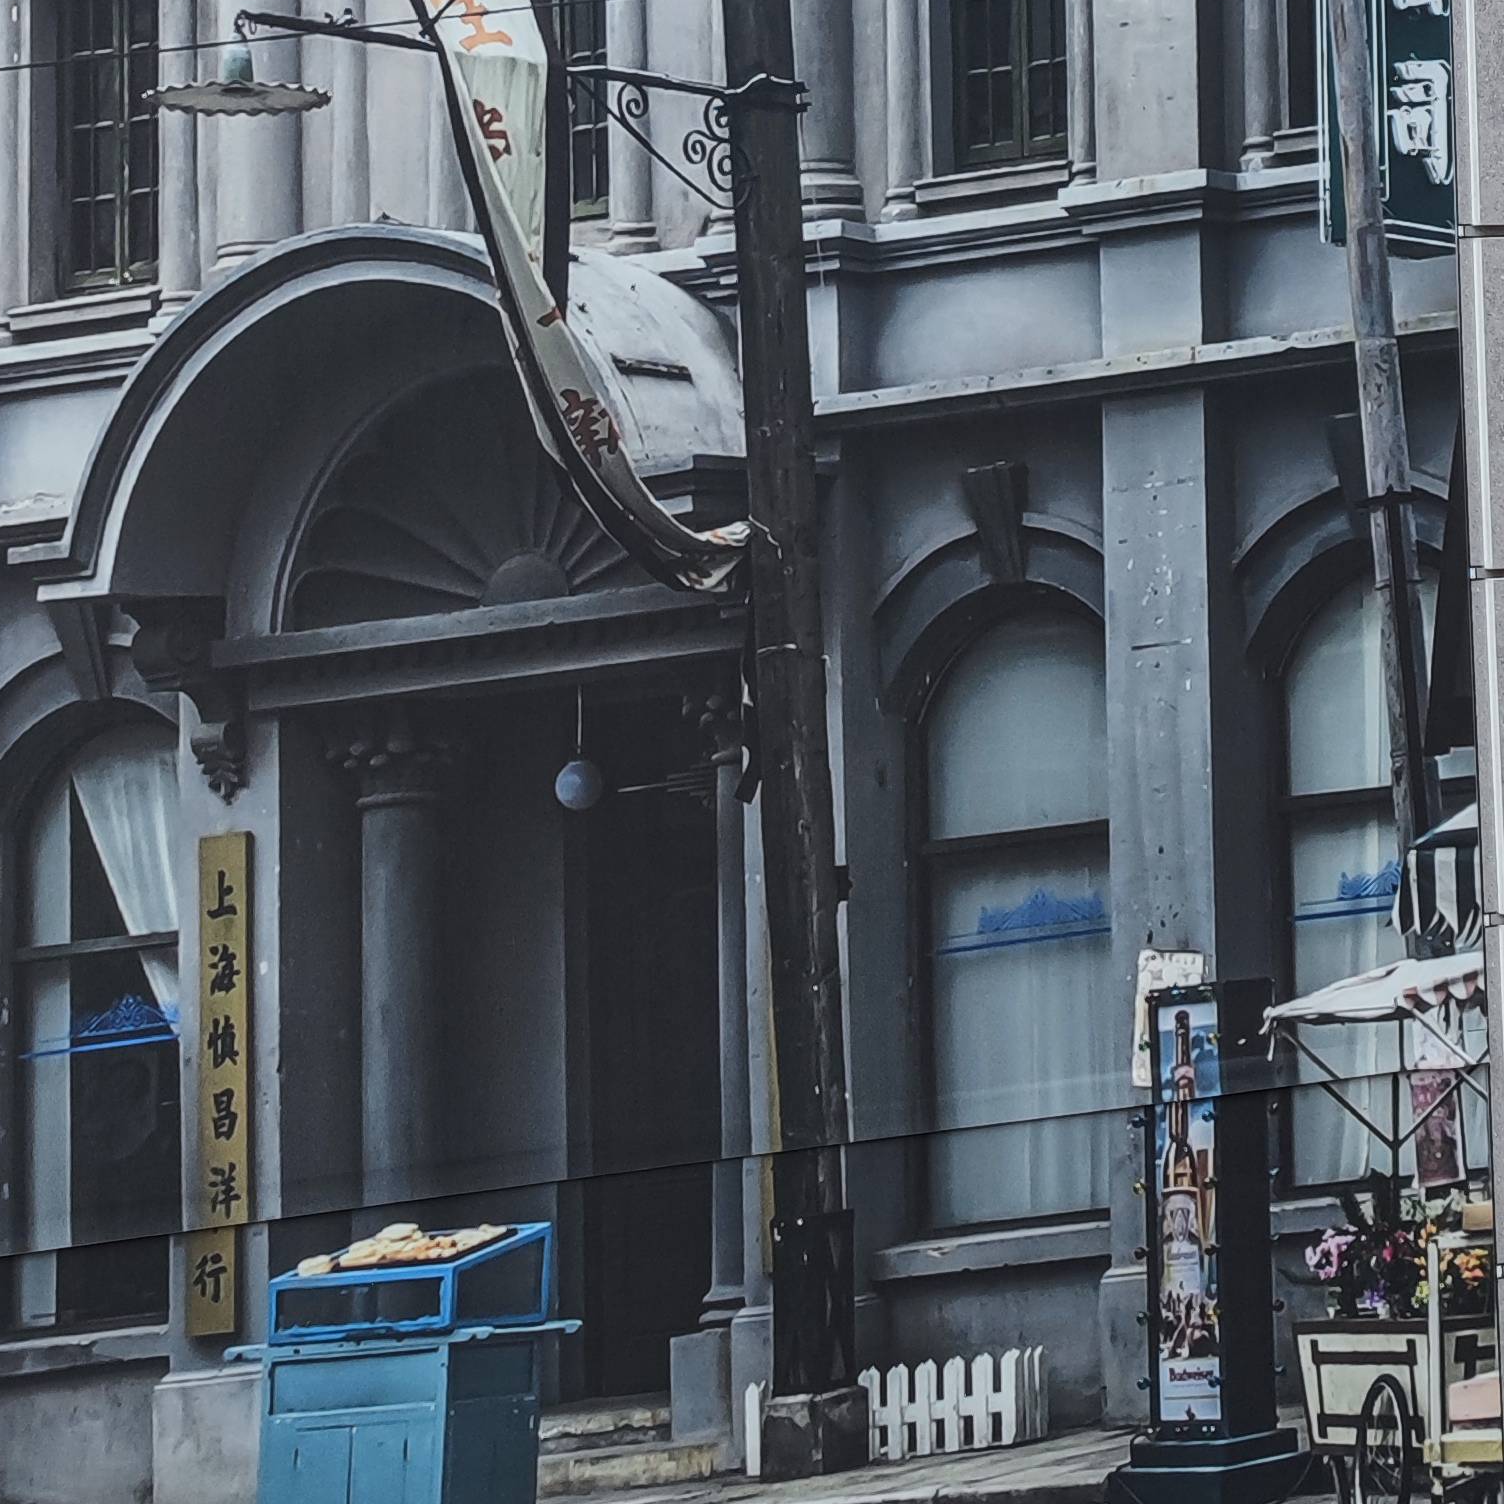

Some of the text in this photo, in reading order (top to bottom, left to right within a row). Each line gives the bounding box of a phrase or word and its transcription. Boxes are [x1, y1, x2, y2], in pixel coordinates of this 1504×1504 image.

[192, 869, 240, 1303] 上海慎昌洋行
